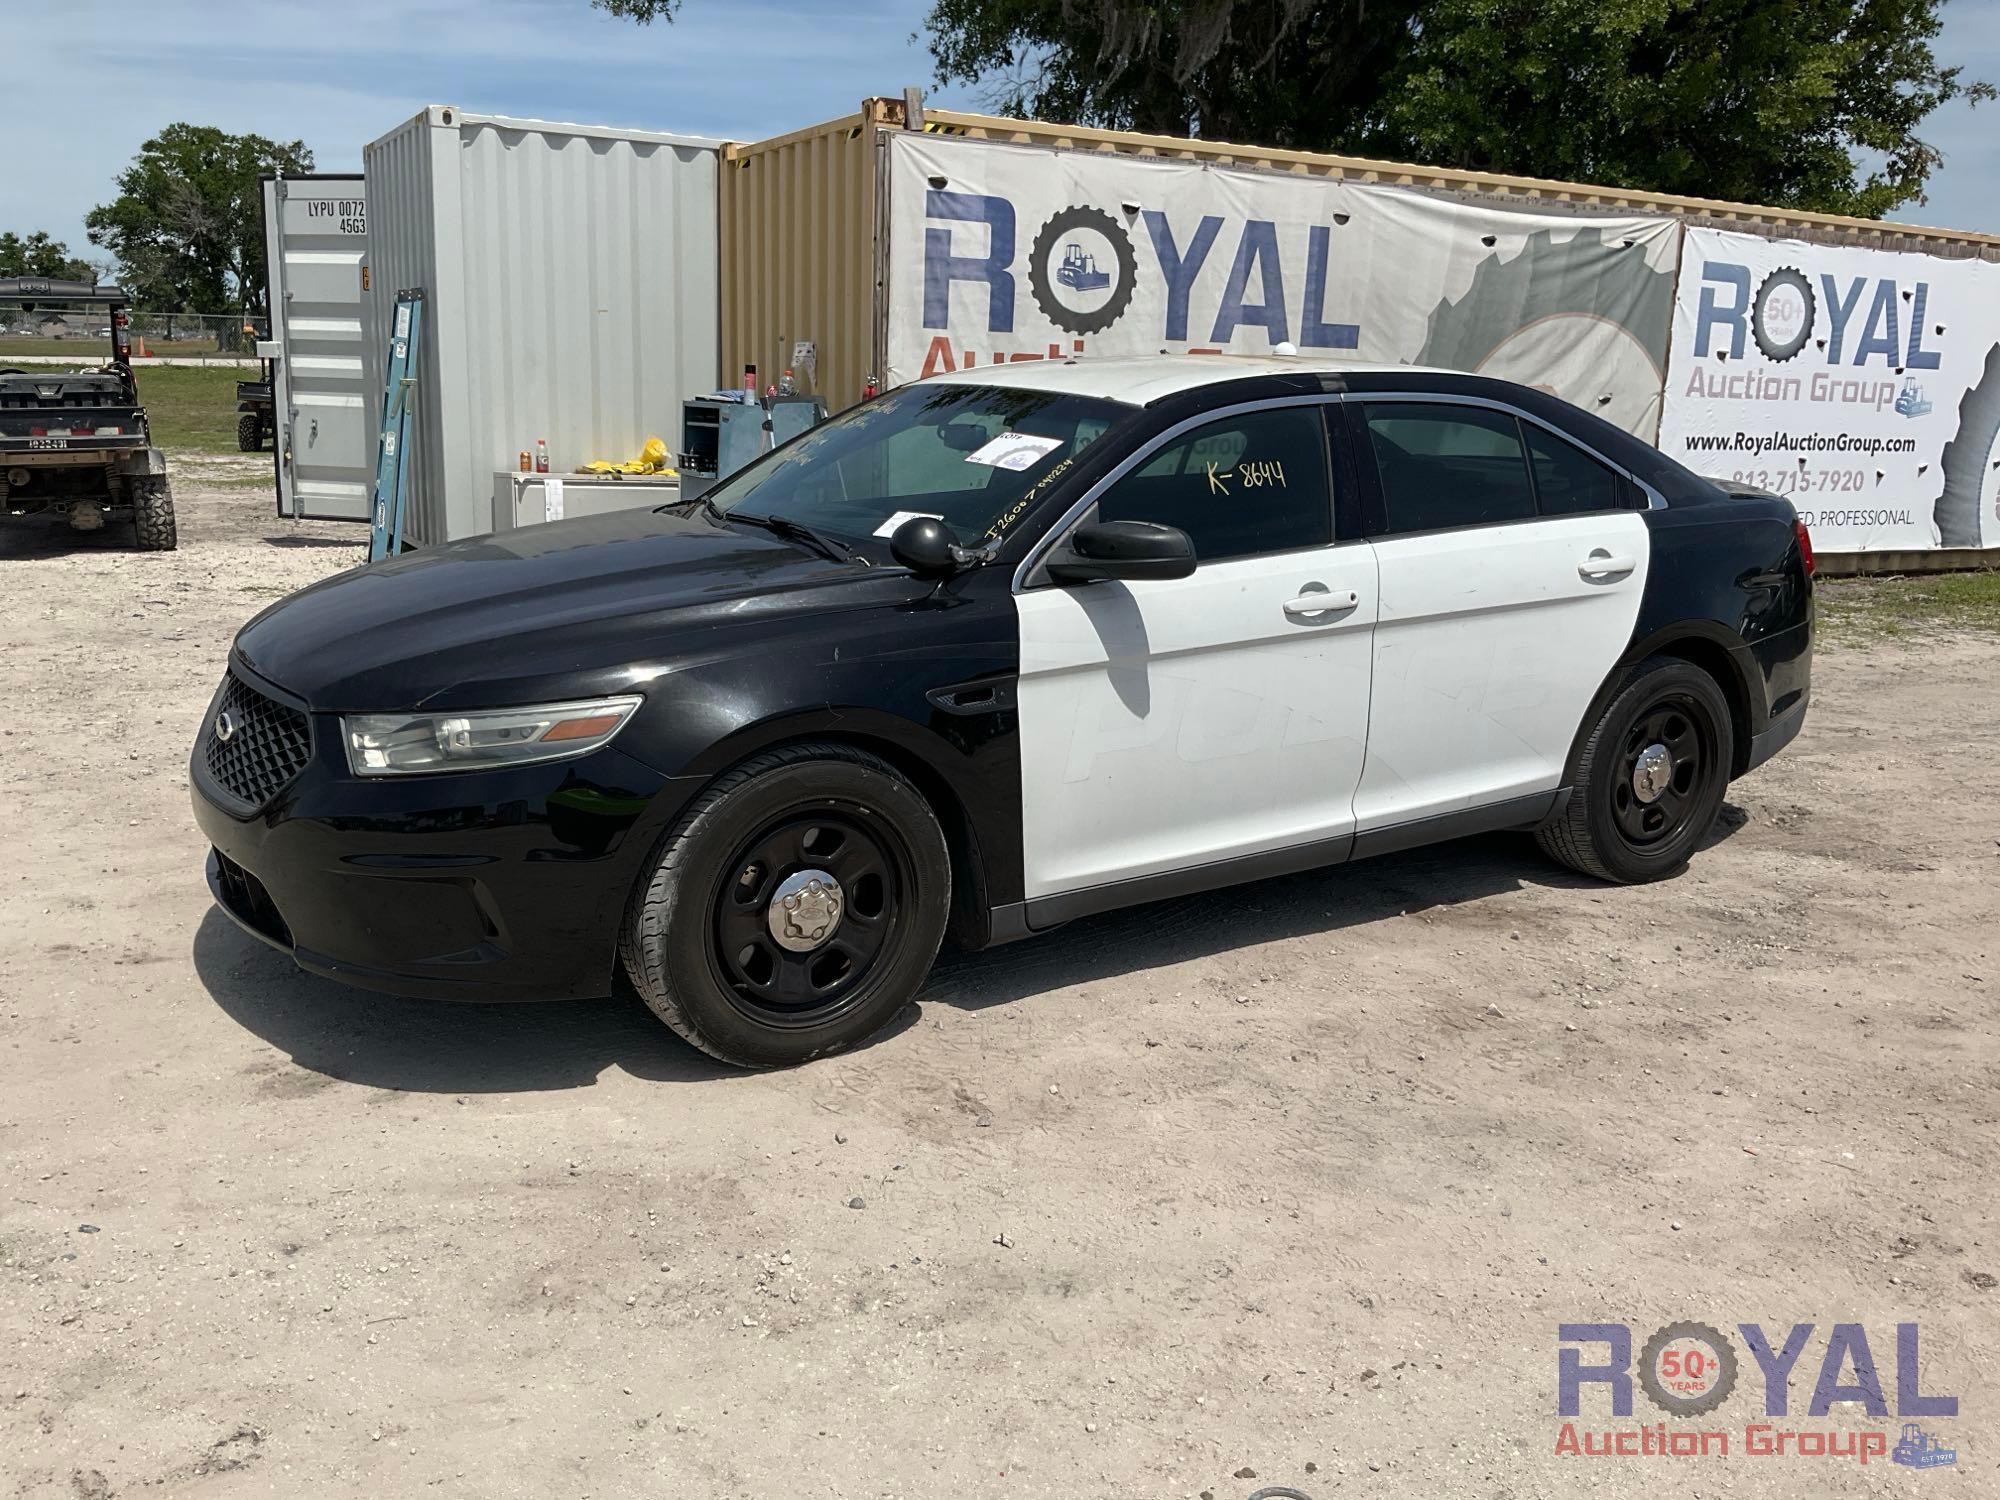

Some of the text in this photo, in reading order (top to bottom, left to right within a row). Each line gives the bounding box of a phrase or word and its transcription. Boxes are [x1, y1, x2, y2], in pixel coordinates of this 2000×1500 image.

[308, 201, 365, 217] LYPU 0072
[340, 218, 366, 233] 45G3
[923, 189, 1360, 349] ROYAL
[1693, 261, 1942, 370] ROYAL
[1685, 366, 1896, 412] Auction Group
[1685, 431, 1916, 456] www.RoyalAuctionGroup.com
[1819, 510, 1915, 527] PROFESSIONAL.
